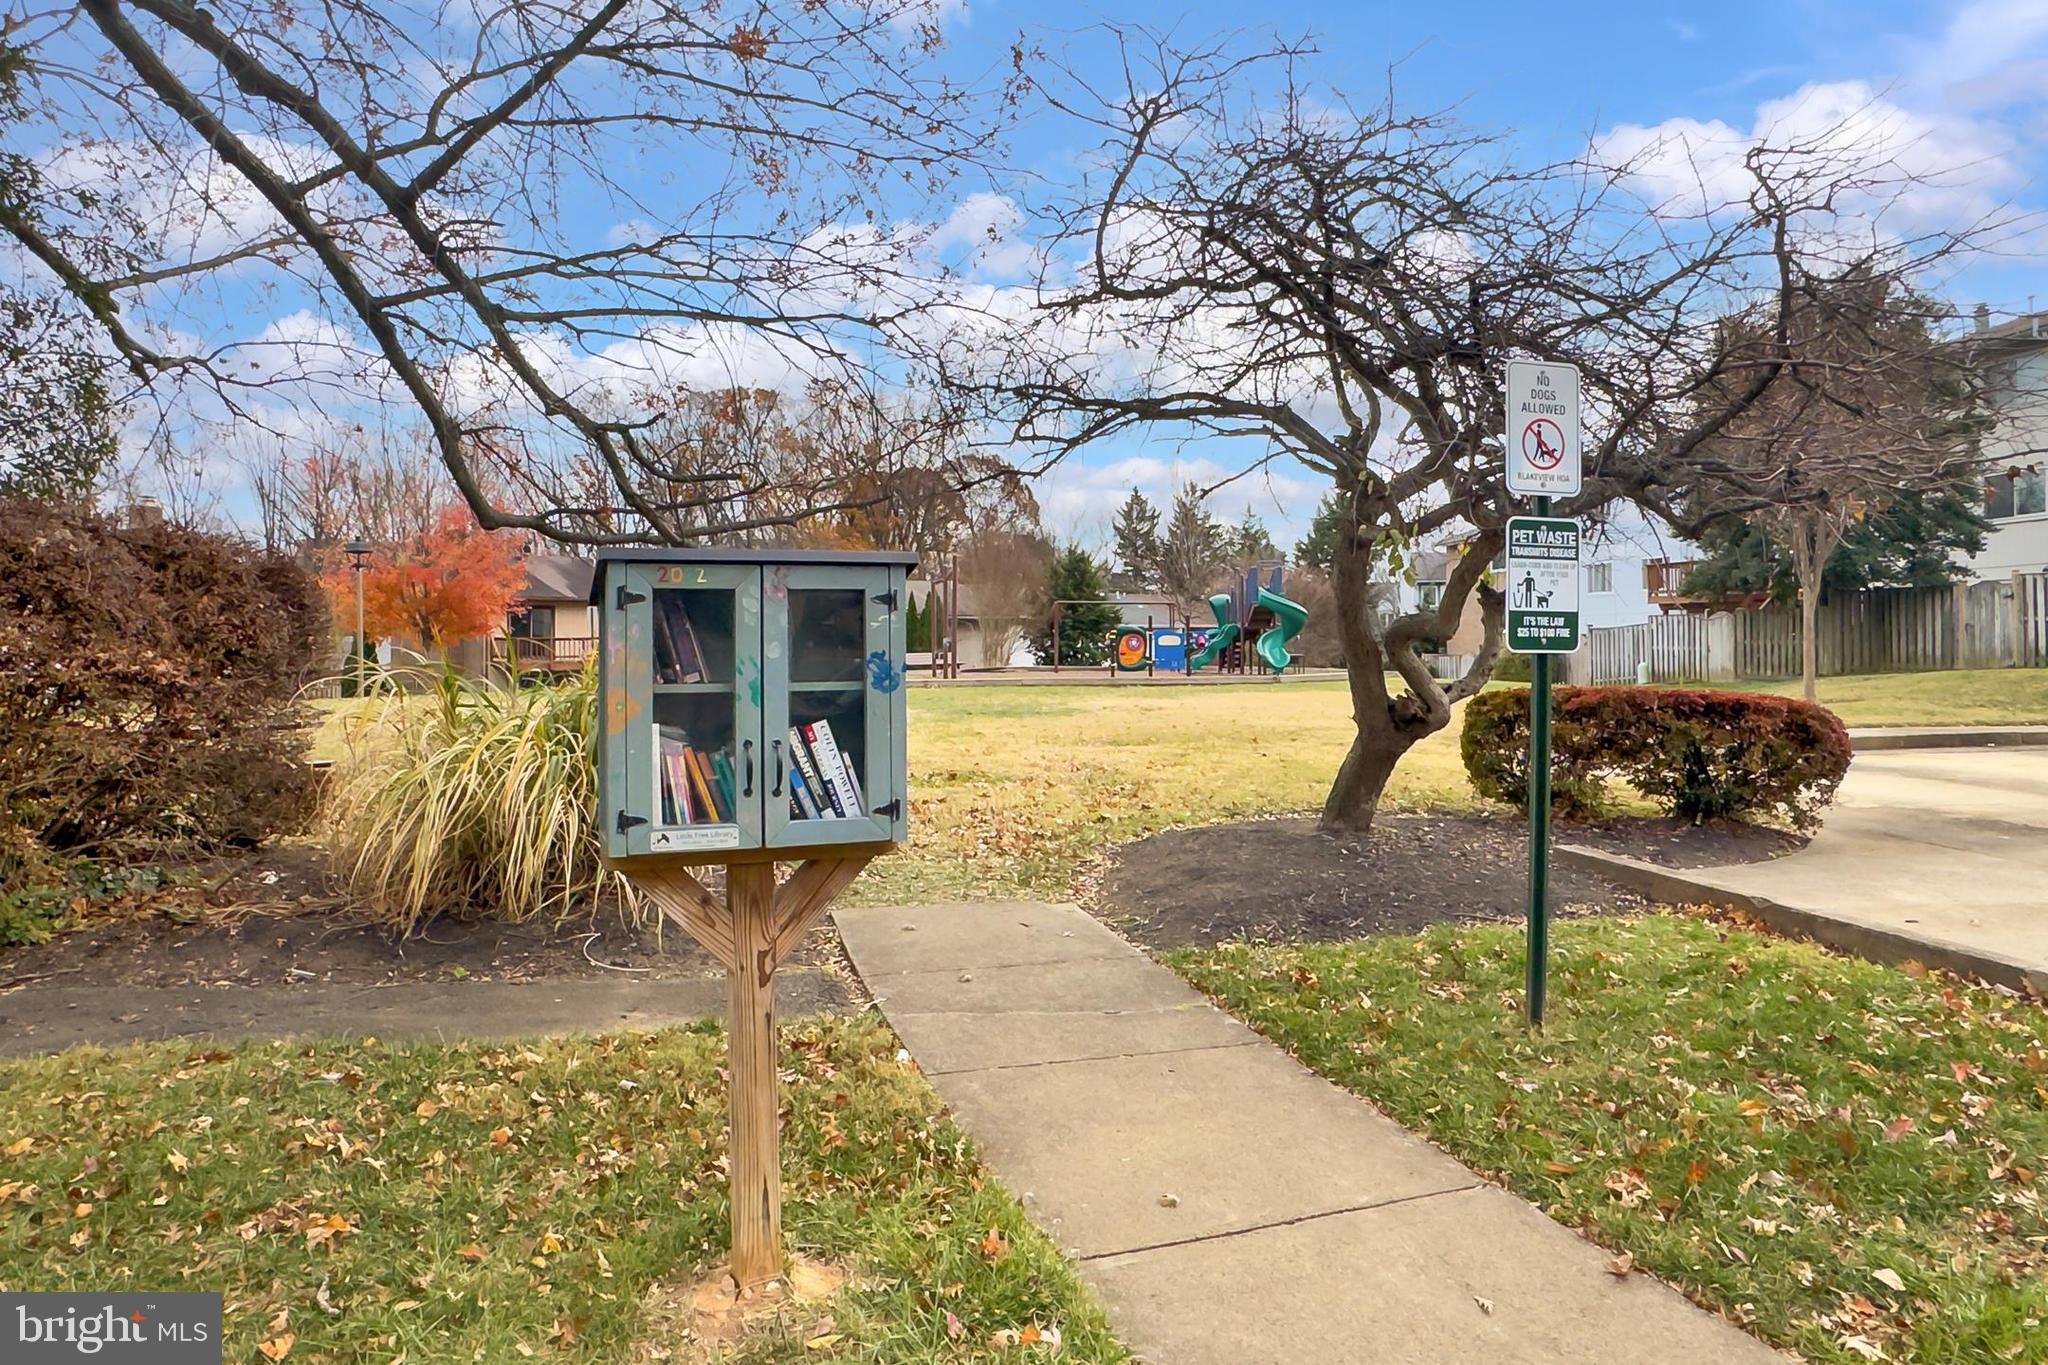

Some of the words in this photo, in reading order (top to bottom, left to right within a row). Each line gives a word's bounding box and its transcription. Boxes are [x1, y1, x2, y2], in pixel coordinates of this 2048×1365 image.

[1537, 375, 1550, 387] NO
[1531, 389, 1556, 401] DOGS
[1521, 402, 1566, 416] ALLOWED
[1512, 529, 1534, 543] PET
[1536, 530, 1577, 545] WASTE
[1511, 546, 1549, 557] TRANSMITS
[1549, 548, 1577, 558] DISEASE
[1523, 616, 1536, 626] IT'S
[1537, 616, 1549, 626] THE
[1550, 617, 1565, 627] LAW
[1530, 628, 1539, 638] TO
[1556, 628, 1571, 638] FINE
[820, 725, 837, 760] COLIN
[835, 765, 856, 807] POWELL
